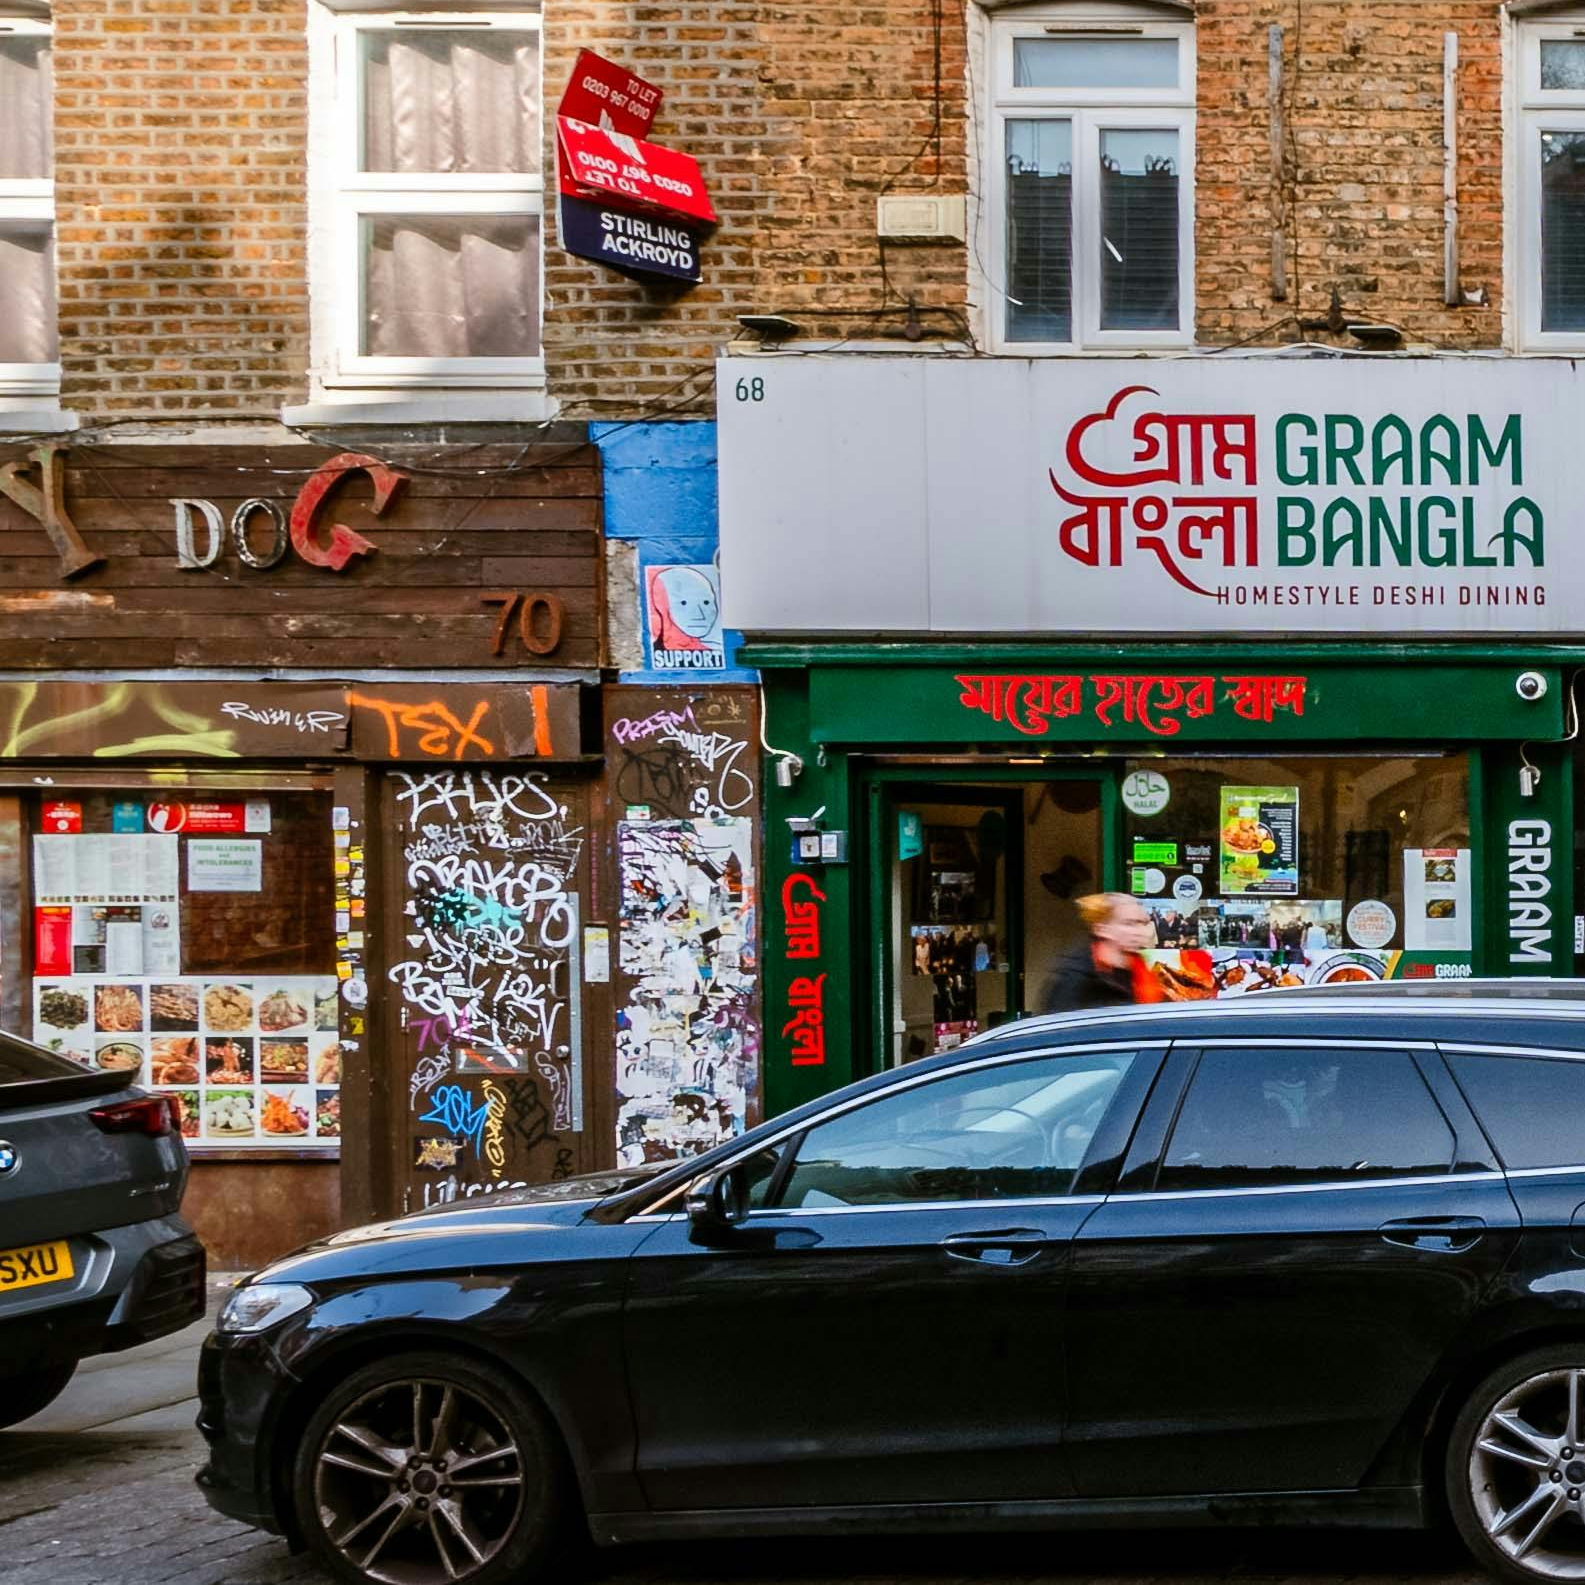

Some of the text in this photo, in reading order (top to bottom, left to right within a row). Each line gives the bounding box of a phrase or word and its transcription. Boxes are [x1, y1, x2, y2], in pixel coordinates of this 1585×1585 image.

[626, 78, 658, 104] TO LET
[577, 150, 618, 173] 0010
[585, 170, 642, 195] TO LET
[653, 172, 693, 197] 0203
[601, 213, 691, 249] STIRLING
[602, 234, 693, 270] ACKROYD
[735, 377, 765, 402] 68
[1066, 385, 1257, 487] গ্রাম
[1275, 412, 1523, 486] GRAAM
[168, 451, 404, 572] DOG
[1049, 468, 1258, 596] বাংলা
[1277, 495, 1545, 568] BANGLA
[1217, 585, 1545, 606] HOMESTYLE DESHI DINING
[479, 592, 562, 657] 70
[655, 649, 723, 668] SUPPORT
[954, 674, 1084, 736] মায়ের
[1090, 674, 1217, 736] হাতের
[1507, 818, 1553, 963] GRAAM
